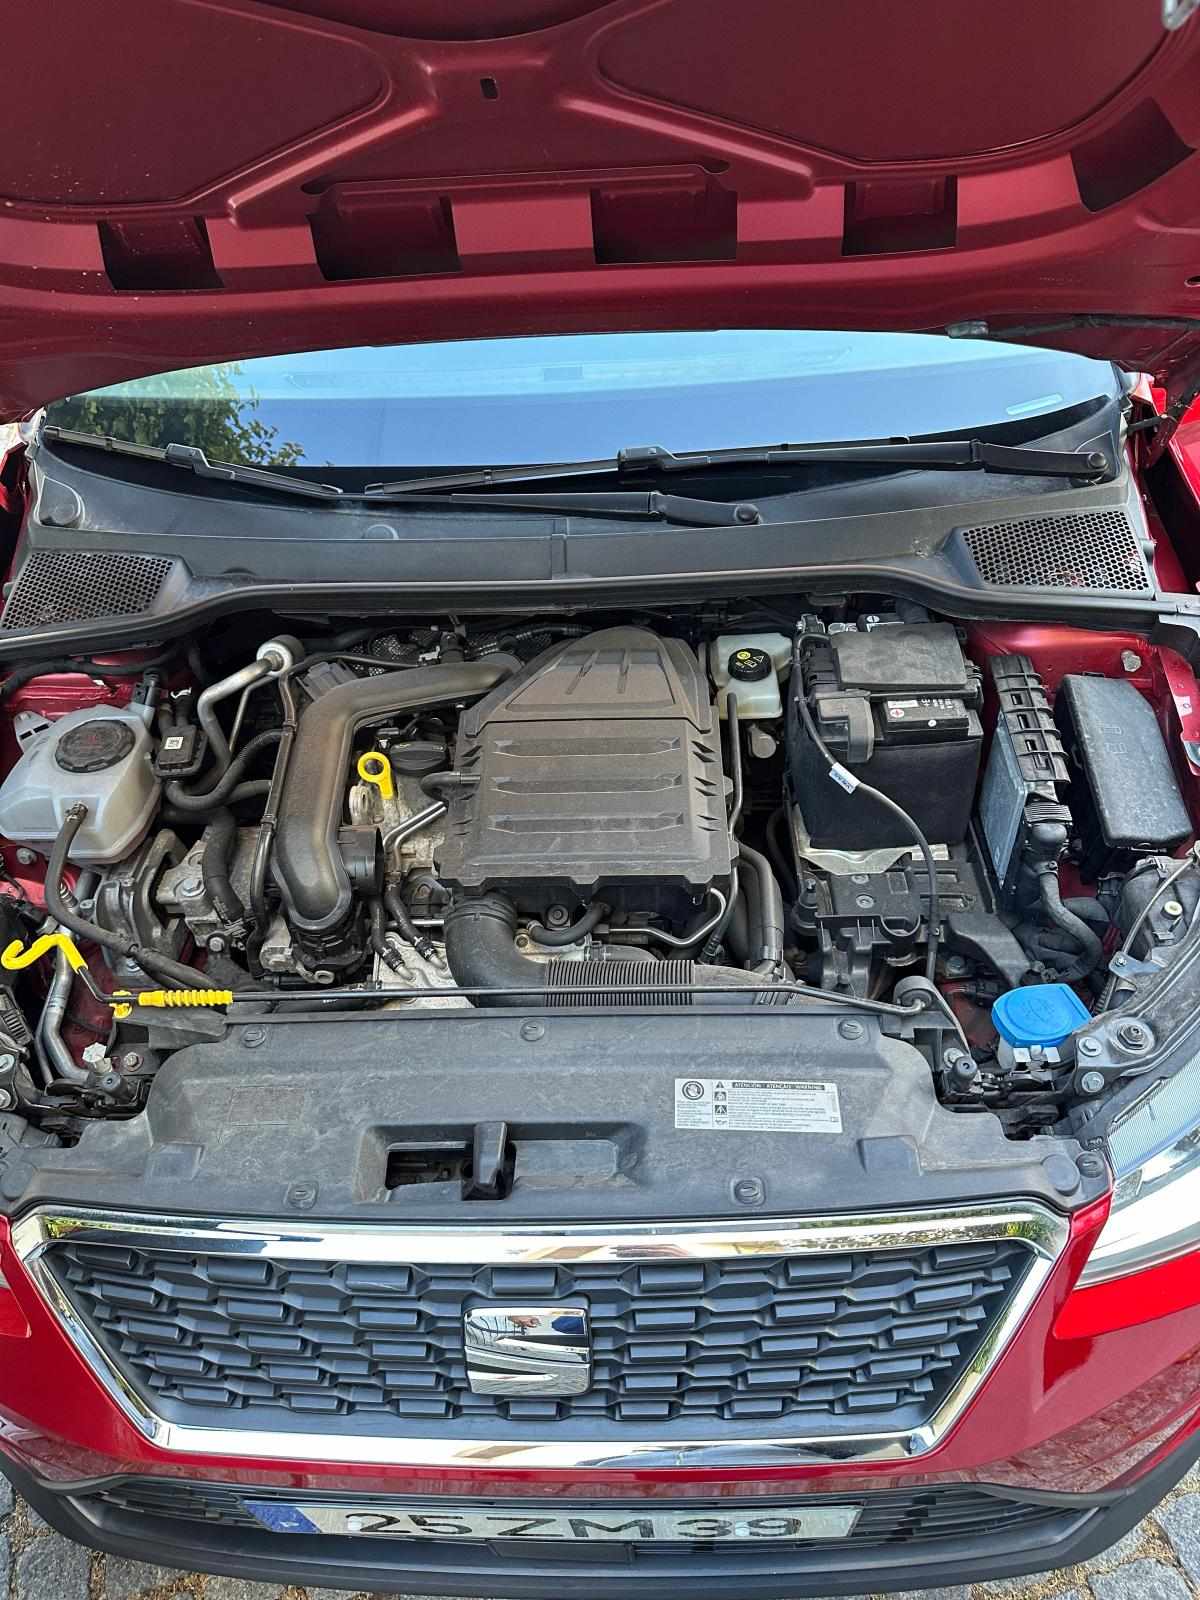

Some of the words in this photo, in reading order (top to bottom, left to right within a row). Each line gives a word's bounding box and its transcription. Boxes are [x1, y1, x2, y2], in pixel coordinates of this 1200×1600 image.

[345, 1512, 473, 1535] 25
[486, 1516, 655, 1538] ZM
[677, 1518, 802, 1538] 39
